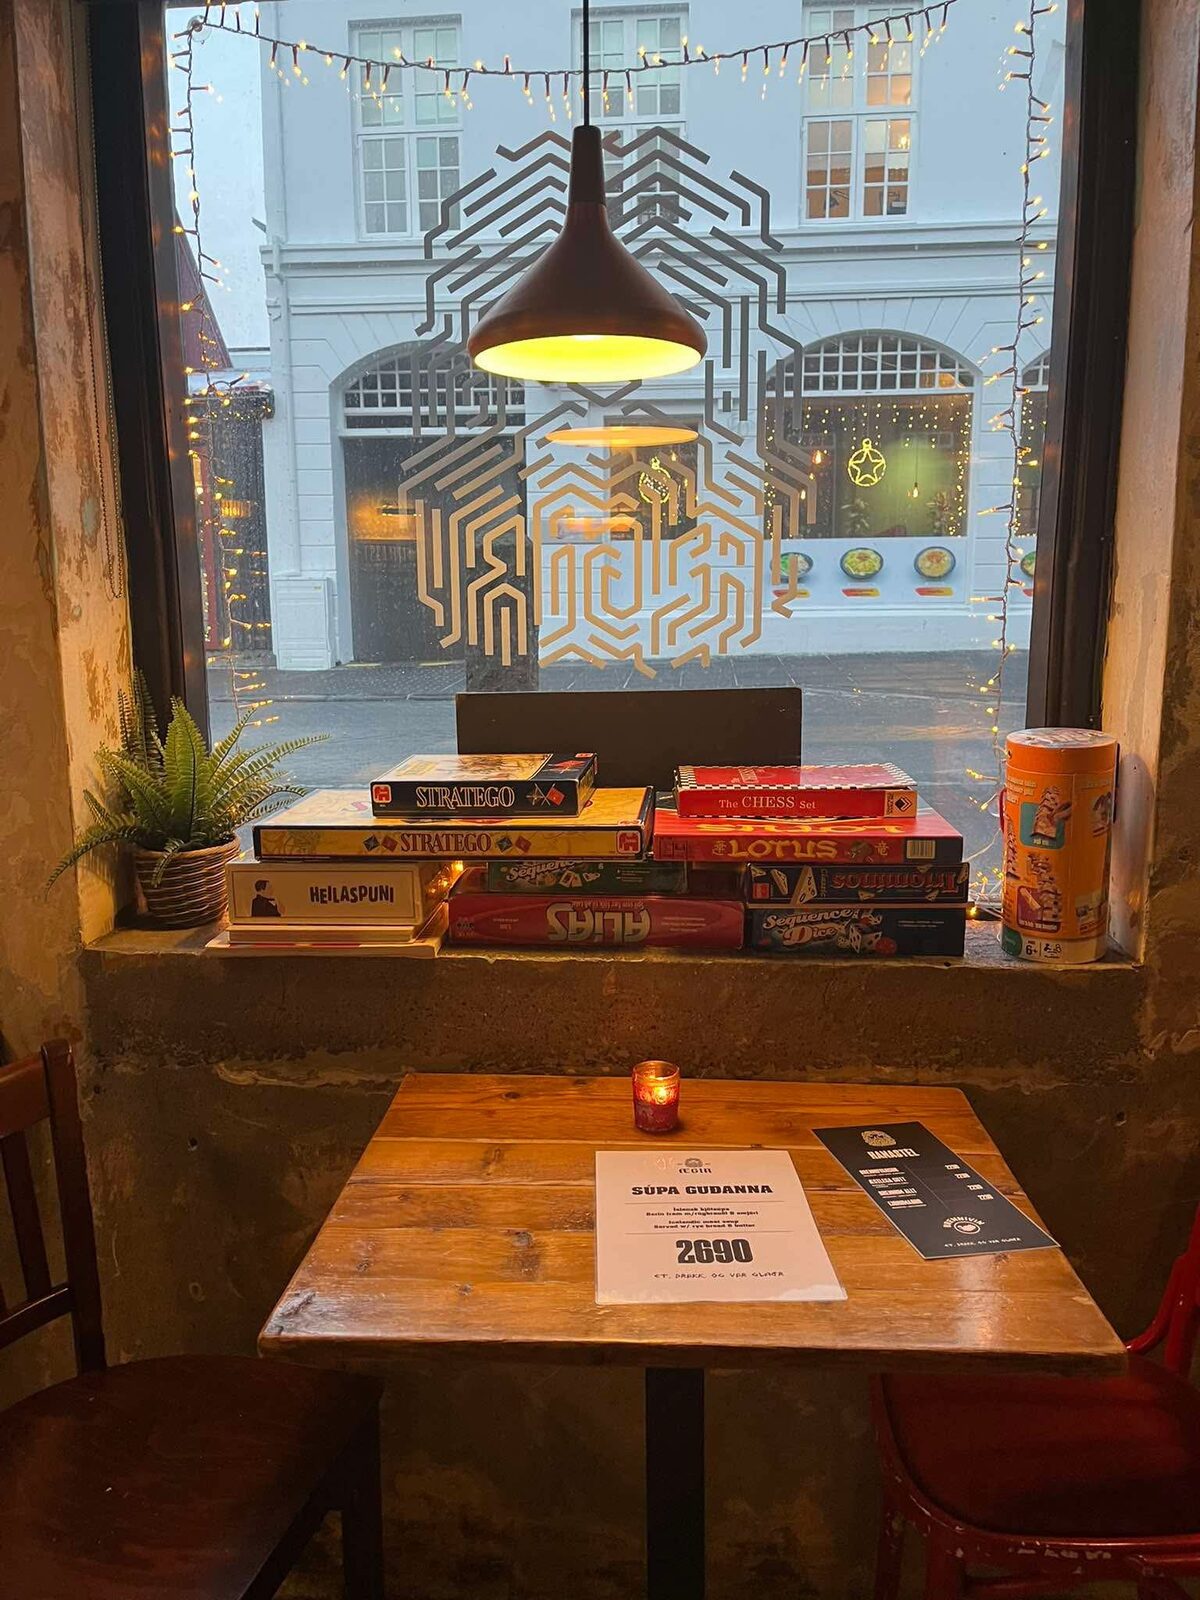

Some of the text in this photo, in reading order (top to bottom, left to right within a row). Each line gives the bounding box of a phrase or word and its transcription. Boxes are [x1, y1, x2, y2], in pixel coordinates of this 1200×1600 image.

[416, 785, 515, 811] STRATEGO
[719, 795, 816, 809] The CHESS Set
[400, 832, 491, 854] STRATEGO
[309, 885, 394, 904] HEILASPUNI
[763, 908, 853, 930] Sequence
[783, 925, 837, 945] Dice
[631, 1184, 680, 1195] SÚPA
[676, 1238, 754, 1264] 2690
